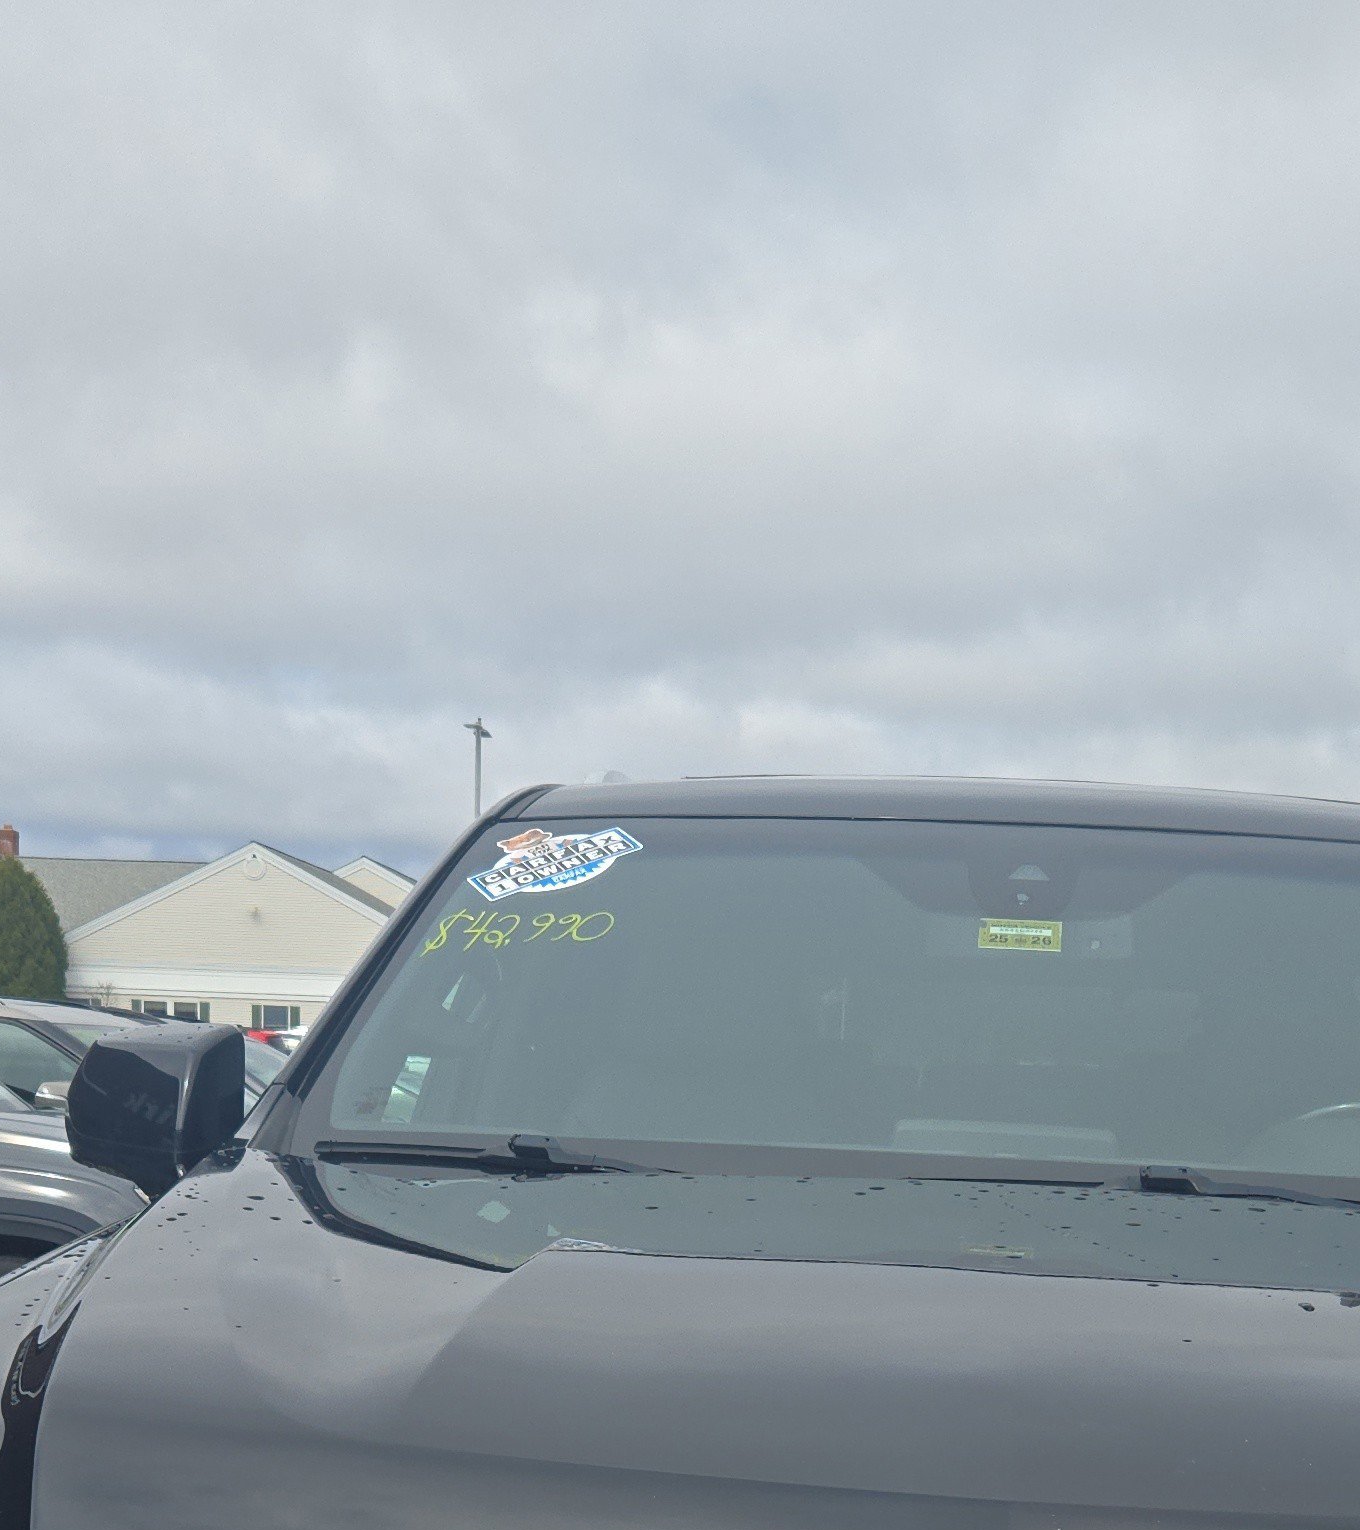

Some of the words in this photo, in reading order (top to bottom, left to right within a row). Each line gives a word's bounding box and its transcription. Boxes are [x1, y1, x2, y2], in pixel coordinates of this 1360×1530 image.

[483, 834, 616, 884] CARFAX
[516, 841, 628, 884] OWNER
[420, 908, 615, 958] $42,990
